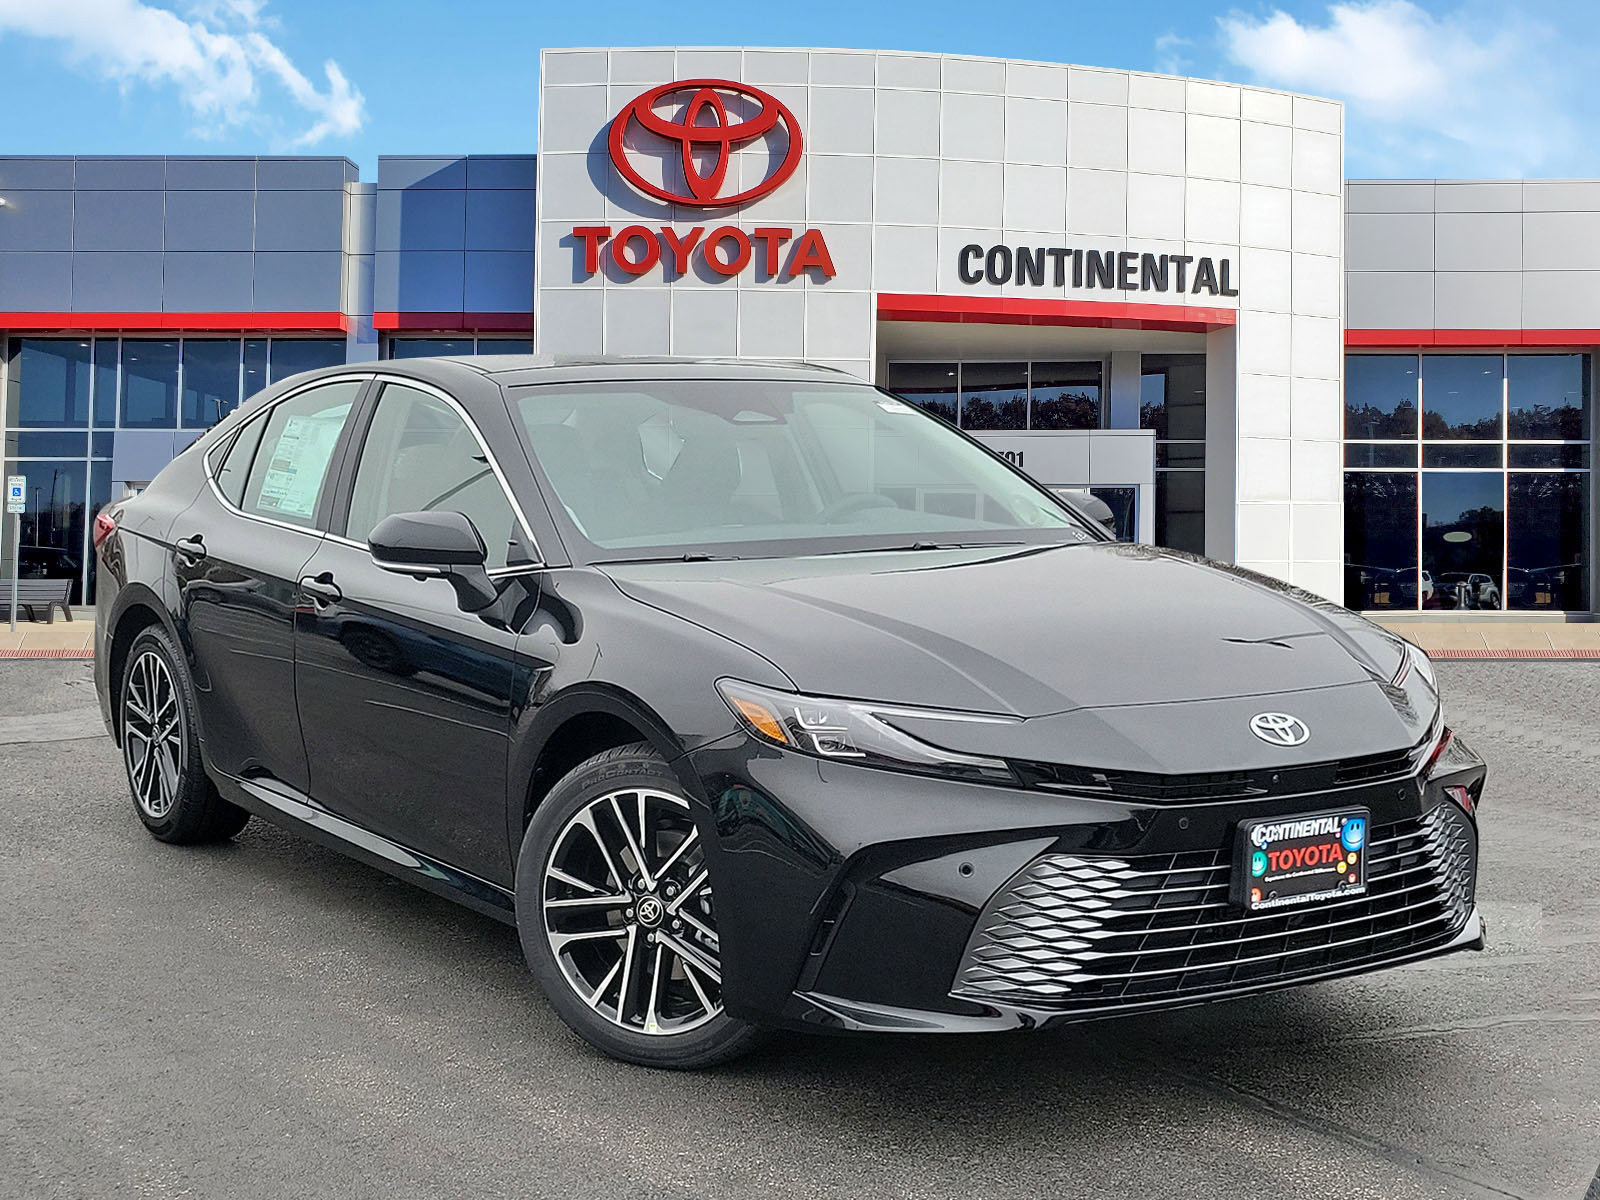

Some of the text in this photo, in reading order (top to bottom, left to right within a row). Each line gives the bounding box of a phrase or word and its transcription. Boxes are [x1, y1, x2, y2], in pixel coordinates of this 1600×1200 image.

[572, 225, 836, 276] TOYOTA
[958, 244, 1239, 296] CONTINENTAL
[1251, 816, 1341, 847] CONTINENTAL
[1268, 843, 1343, 872] TOYOTA
[1251, 887, 1366, 911] ContinentalToyota.com
